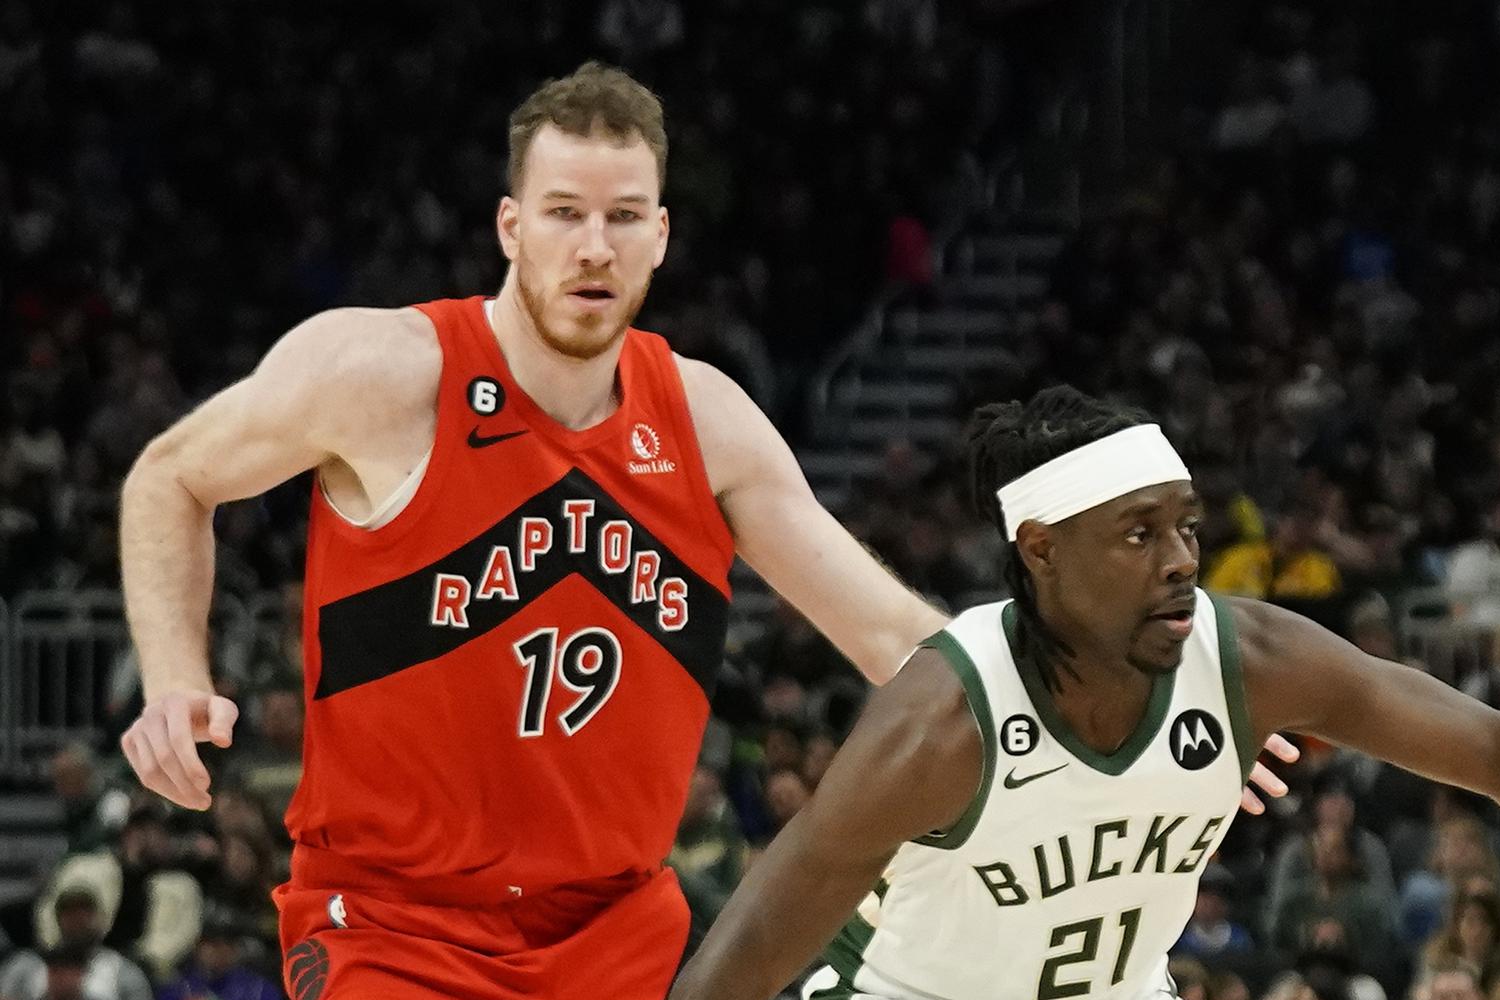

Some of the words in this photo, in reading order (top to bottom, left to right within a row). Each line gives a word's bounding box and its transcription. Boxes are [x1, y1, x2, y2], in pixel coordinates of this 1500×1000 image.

[473, 381, 498, 414] 6
[627, 461, 651, 475] Sun
[651, 459, 677, 474] Life
[431, 498, 689, 632] RAPTORS
[513, 626, 624, 738] 19
[1007, 719, 1031, 753] 6
[972, 814, 1227, 907] BUCKS
